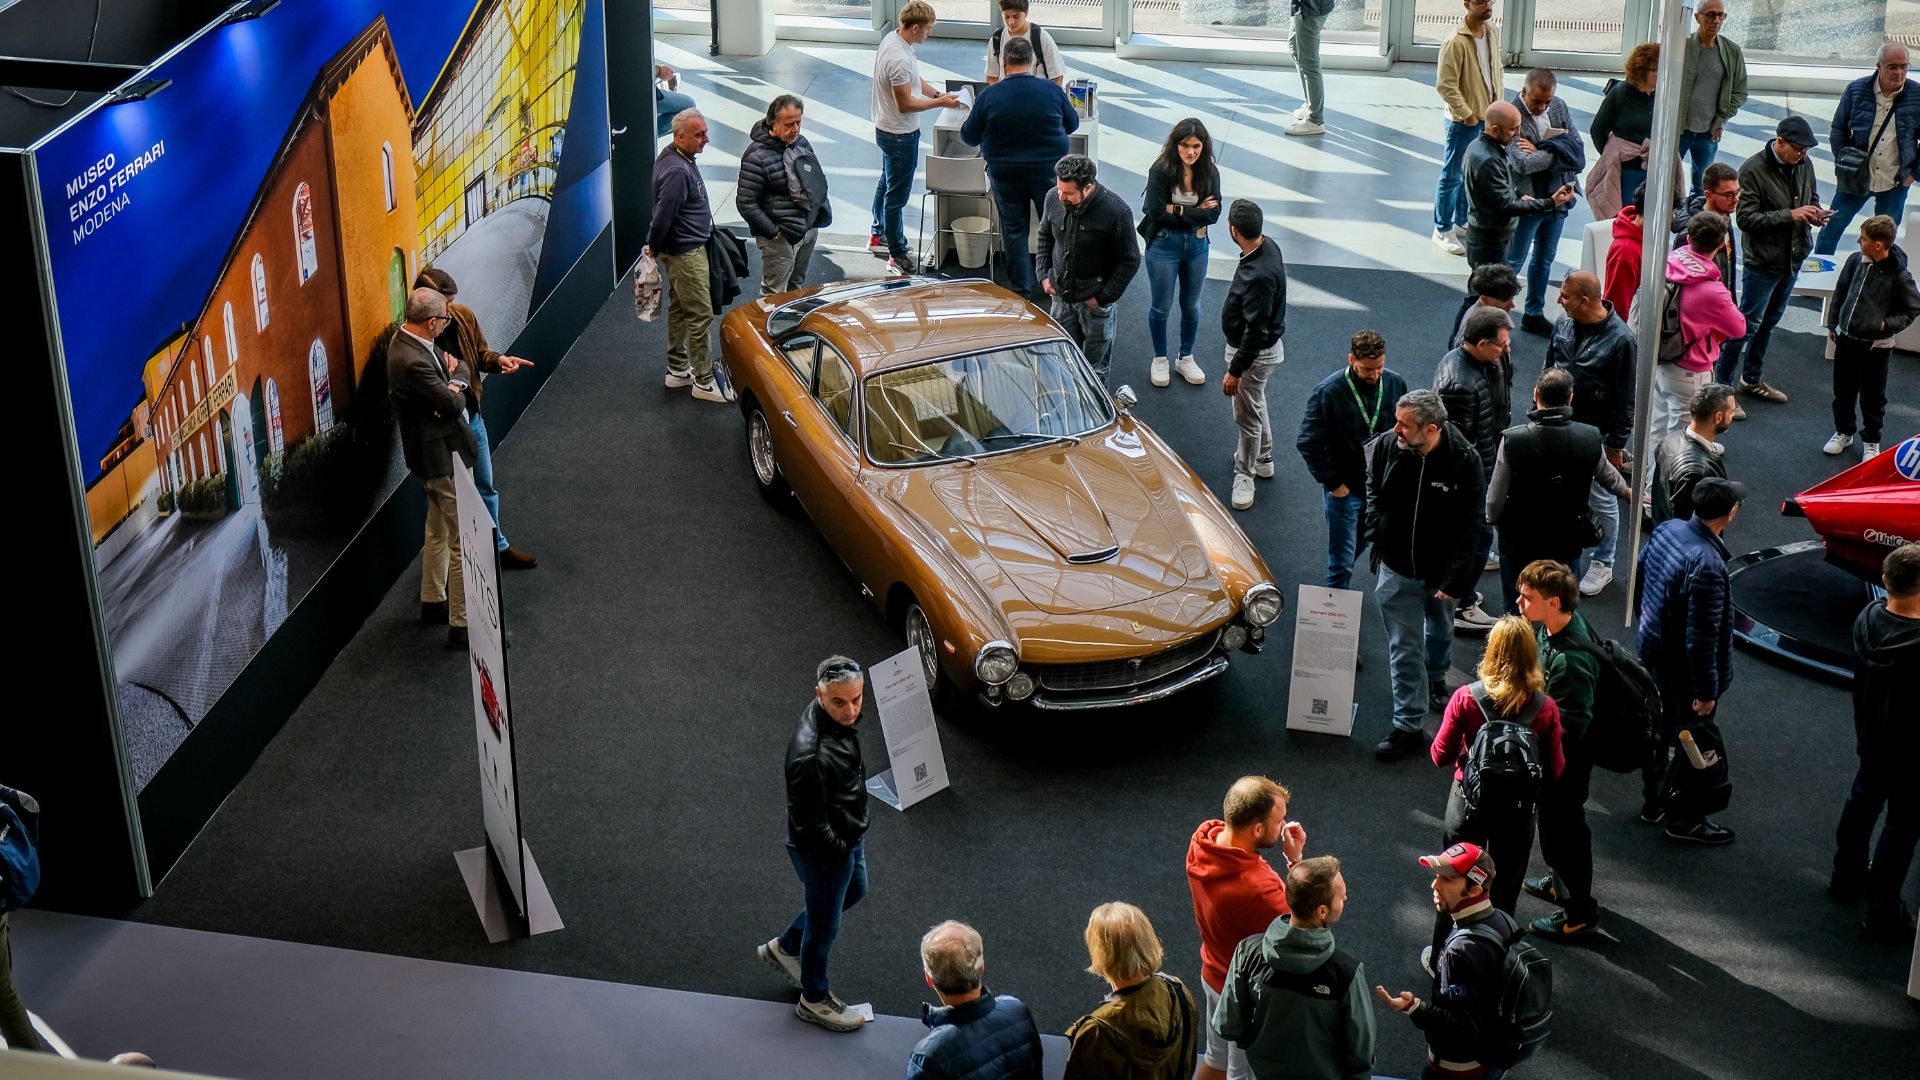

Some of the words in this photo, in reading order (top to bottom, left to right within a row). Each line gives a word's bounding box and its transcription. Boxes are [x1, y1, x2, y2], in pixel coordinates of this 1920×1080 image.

[66, 153, 115, 200] MUSEO
[69, 184, 107, 222] ENZO
[109, 140, 165, 193] FERRARI
[73, 192, 131, 245] MODENA
[462, 535, 497, 630] HITS
